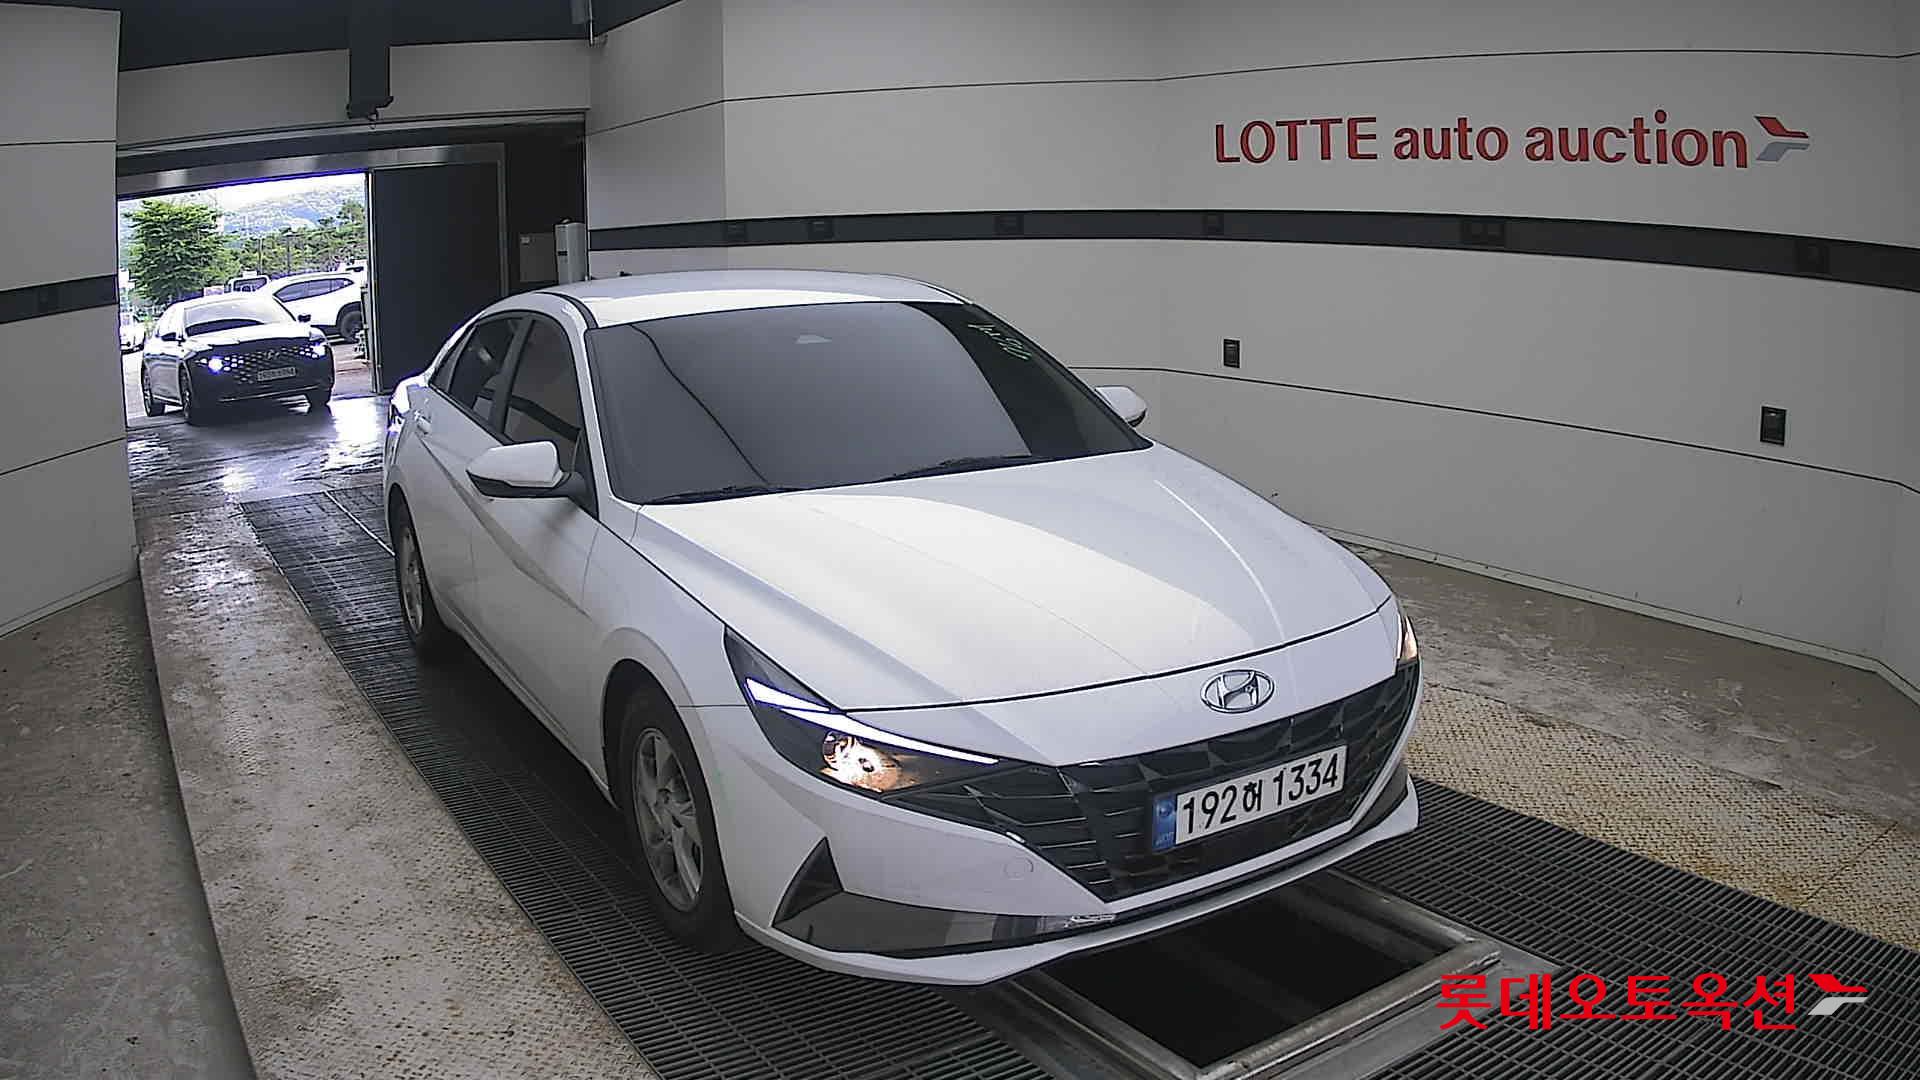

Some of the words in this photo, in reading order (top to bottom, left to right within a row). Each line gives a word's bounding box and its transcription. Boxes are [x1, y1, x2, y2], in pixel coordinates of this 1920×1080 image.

[1215, 117, 1378, 164] LOTTE
[1393, 116, 1510, 162] auto
[1524, 109, 1749, 169] auction
[1182, 778, 1264, 834] 192허
[1272, 752, 1339, 807] 1334
